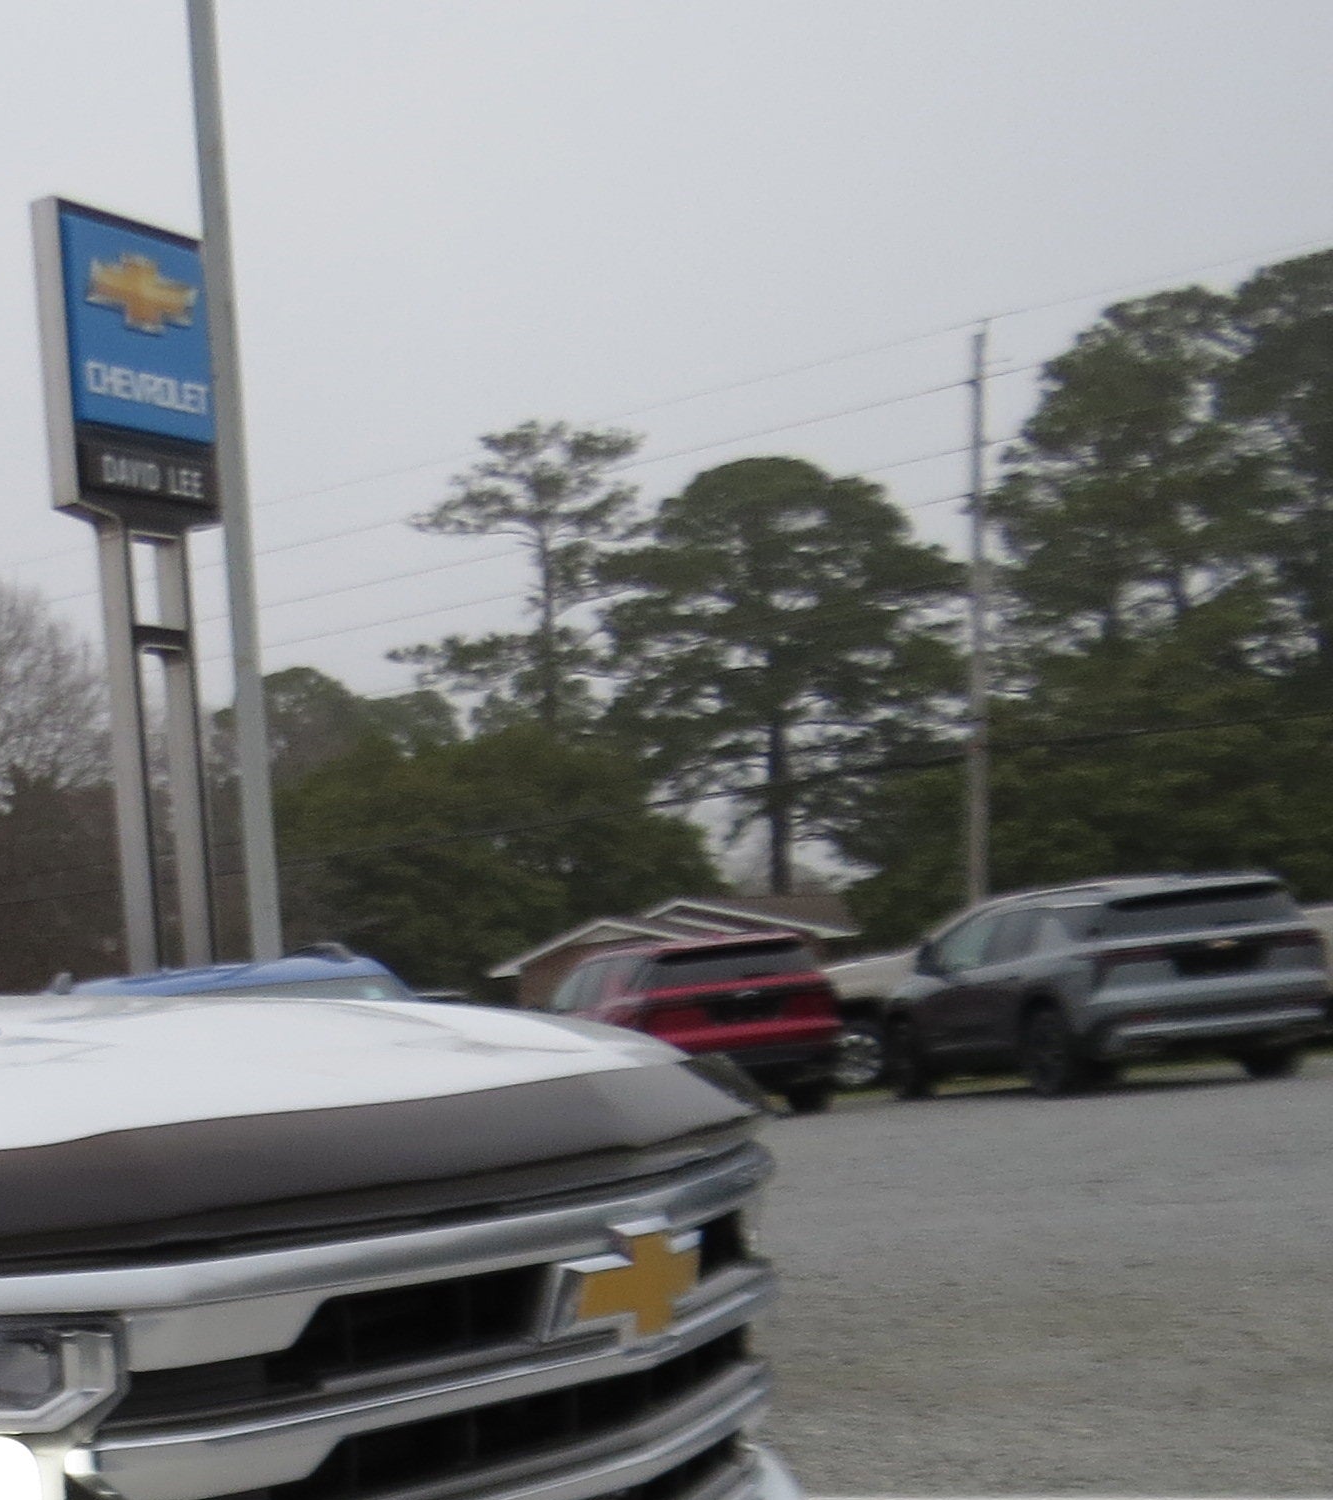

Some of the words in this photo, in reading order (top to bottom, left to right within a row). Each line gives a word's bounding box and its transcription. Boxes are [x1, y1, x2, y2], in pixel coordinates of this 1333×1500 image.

[84, 360, 209, 416] CHEVROLET
[100, 453, 161, 492] DAVID
[167, 466, 205, 499] LEE
